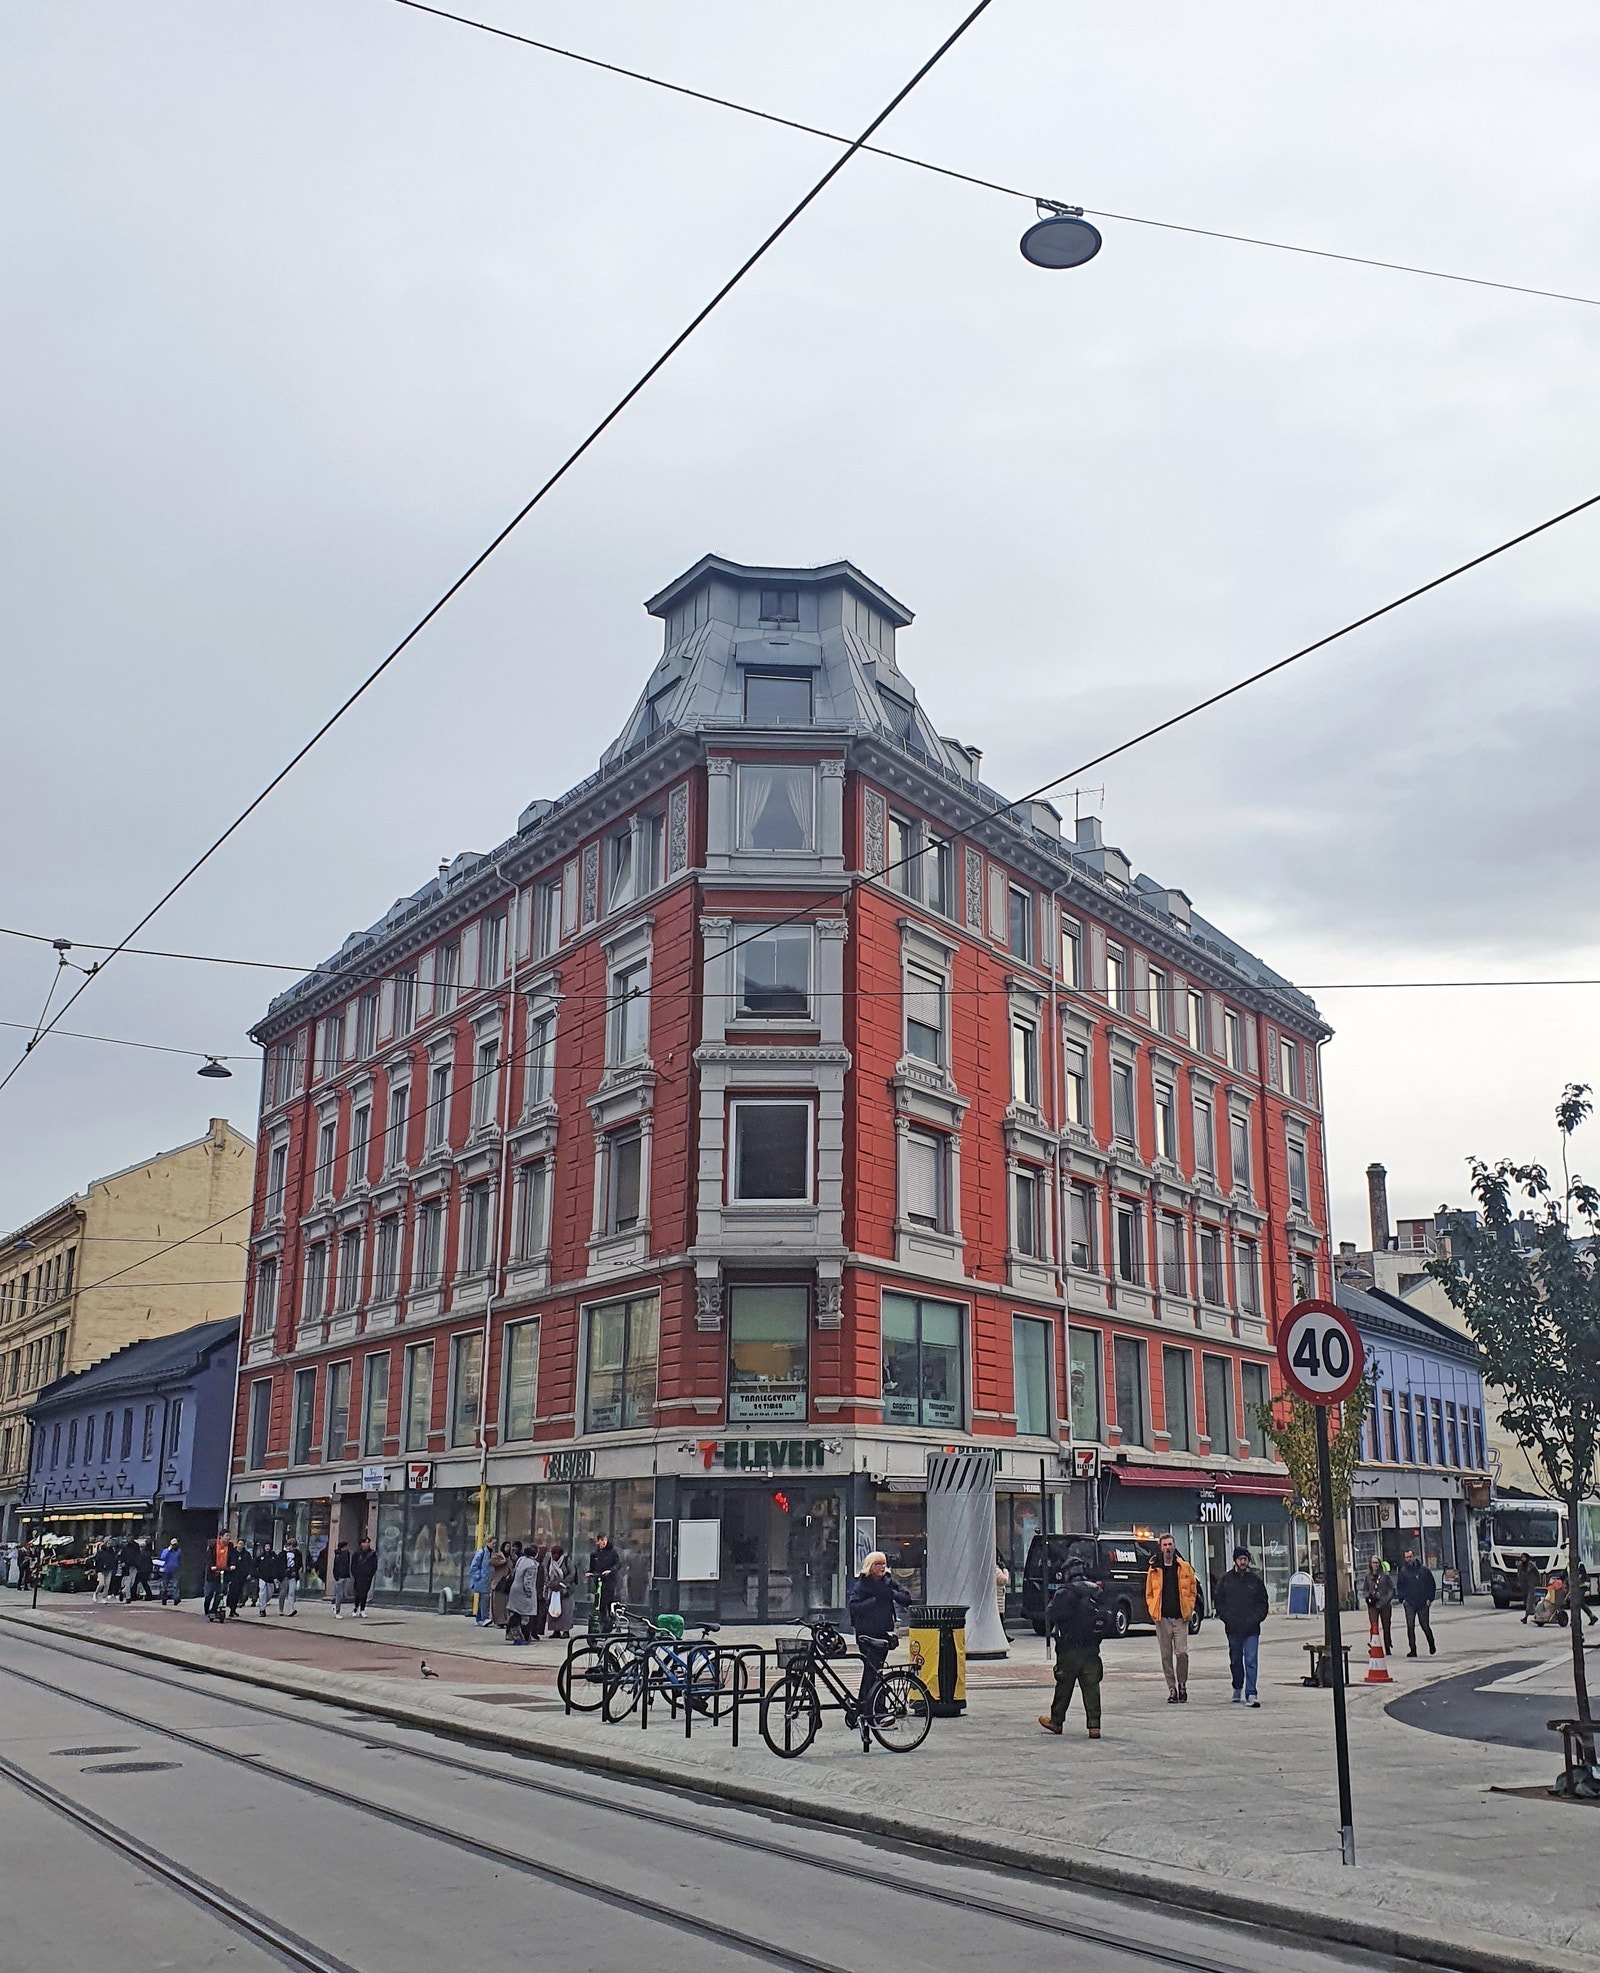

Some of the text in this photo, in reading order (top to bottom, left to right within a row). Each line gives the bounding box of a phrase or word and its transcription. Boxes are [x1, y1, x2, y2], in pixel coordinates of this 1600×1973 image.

[1293, 1328, 1359, 1378] 40
[740, 1394, 797, 1402] TANNLEGEVAKT
[1077, 1452, 1094, 1477] 7
[1200, 1494, 1232, 1522] smile
